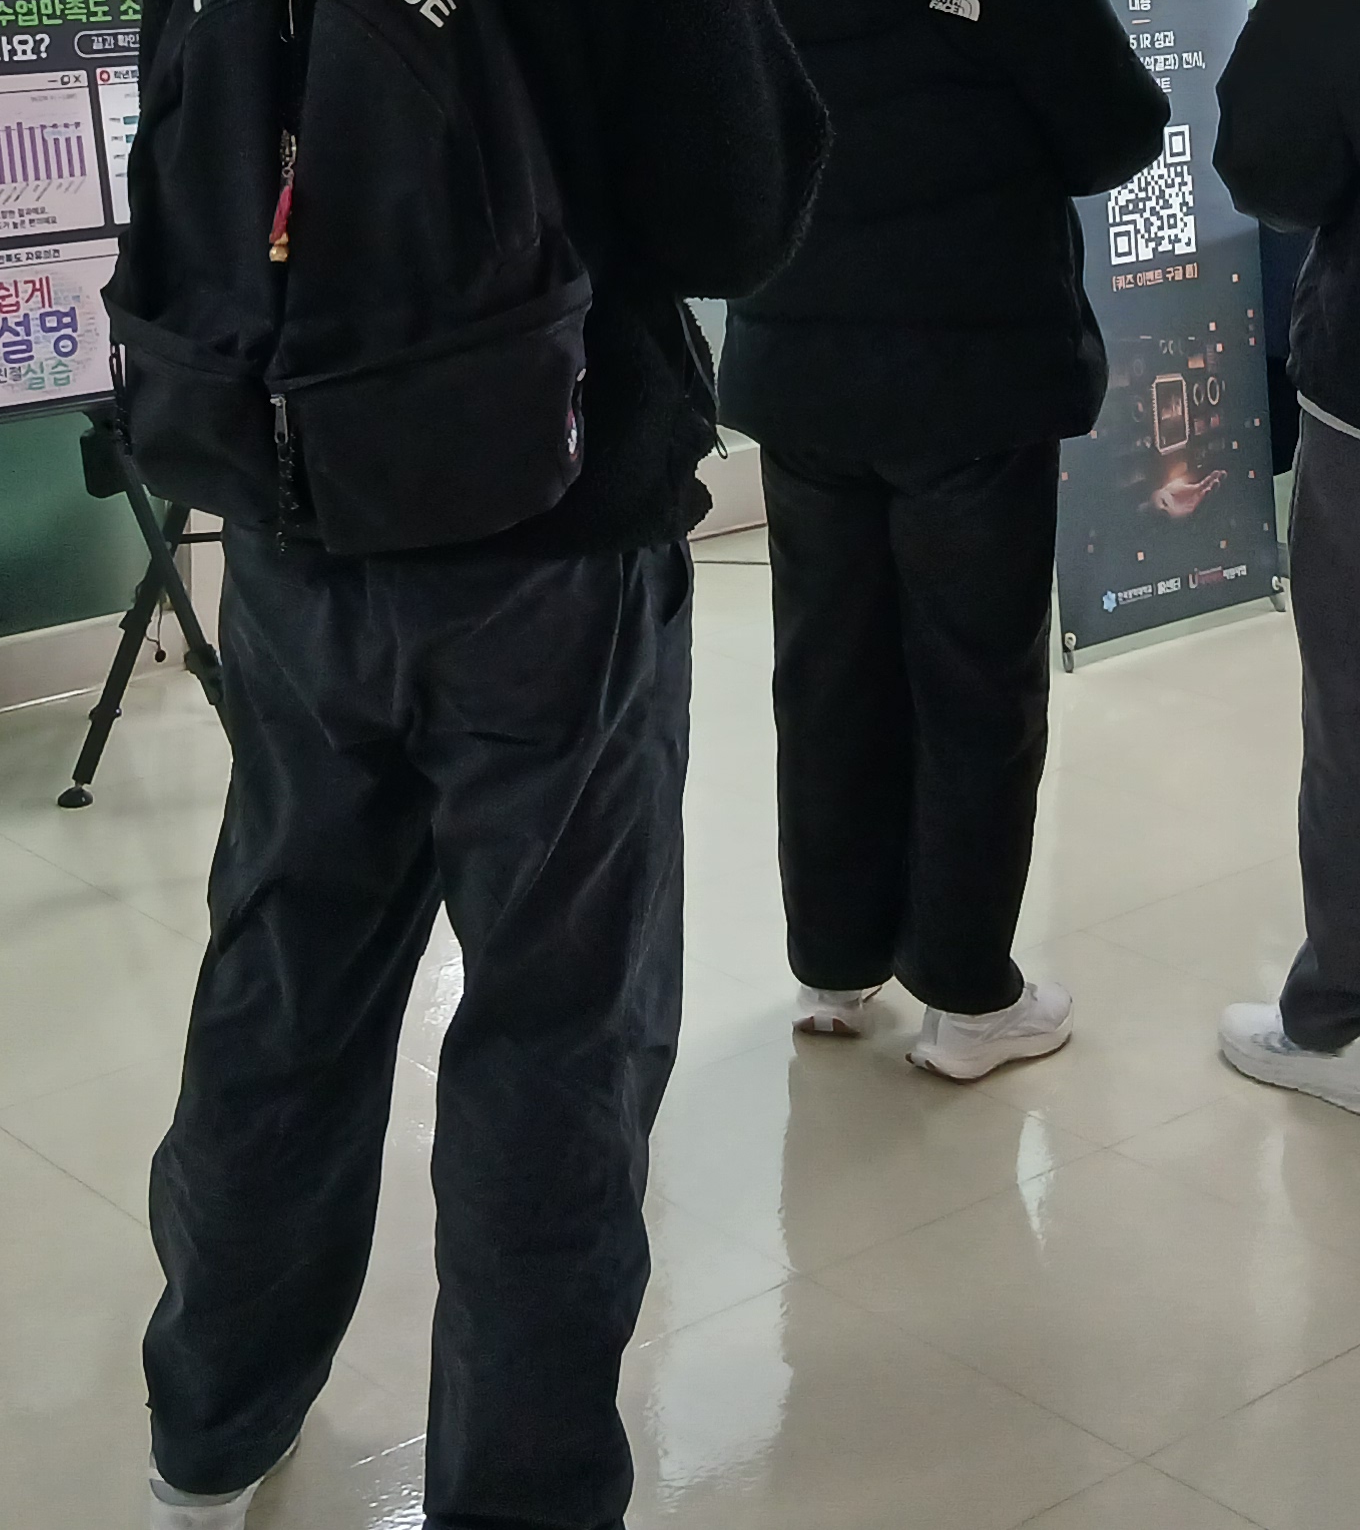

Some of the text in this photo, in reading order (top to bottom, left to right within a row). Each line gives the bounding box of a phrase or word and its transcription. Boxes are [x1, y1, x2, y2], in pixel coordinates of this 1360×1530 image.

[1140, 33, 1152, 49] IR
[1154, 31, 1175, 49] 성과
[23, 359, 73, 391] 실습
